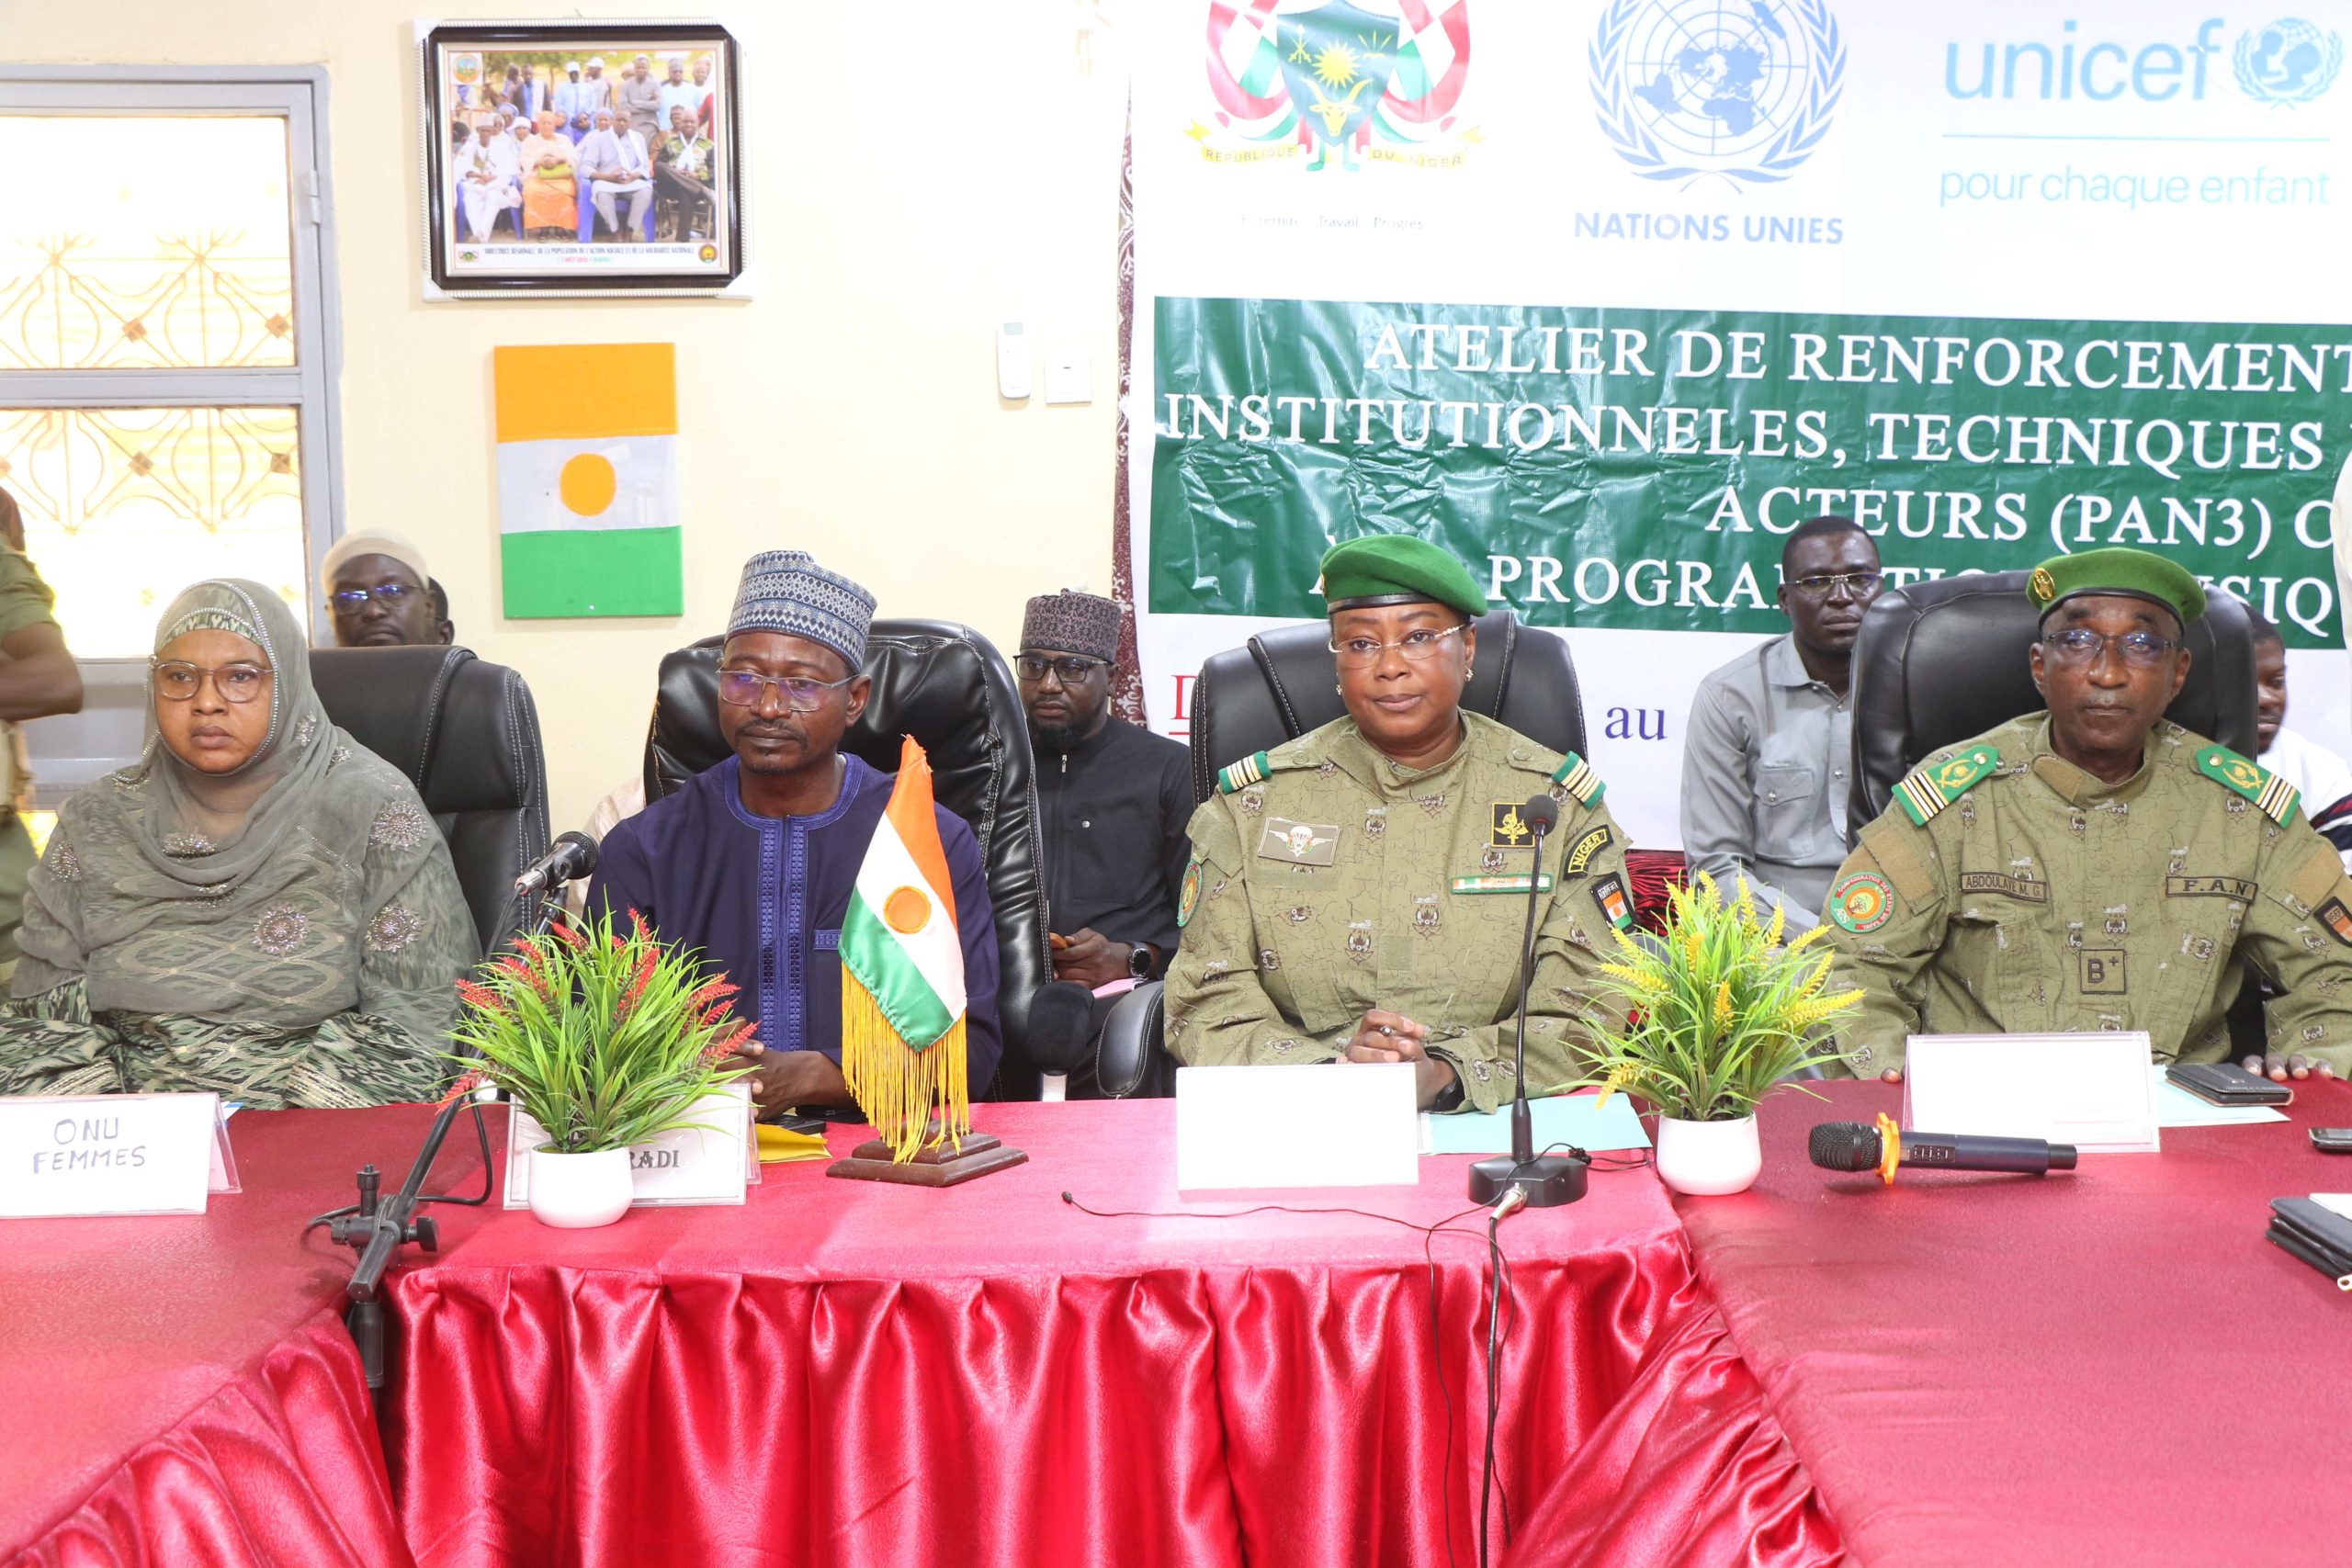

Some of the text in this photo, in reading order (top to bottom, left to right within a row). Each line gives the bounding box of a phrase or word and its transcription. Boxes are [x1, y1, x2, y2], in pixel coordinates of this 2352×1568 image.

[1944, 17, 2224, 102] unicef
[1373, 149, 1395, 160] DU
[1410, 153, 1463, 168] NIGER
[1939, 164, 2331, 210] pour chaque enfant
[1319, 215, 1359, 228] Travail
[1574, 212, 1844, 244] NATIONS UNIES
[1363, 322, 1656, 376] ATELIER
[1673, 329, 1768, 379] DE
[1164, 392, 2324, 480] INSTITUTIONNELES, TECHNIQUES
[1704, 484, 2028, 541] ACTEURS
[2050, 493, 2272, 559] (PAN3)
[1605, 706, 1668, 741] au
[1572, 834, 1600, 866] NIGER
[2183, 879, 2248, 896] F.A.N
[54, 1117, 119, 1145] ONU
[33, 1145, 146, 1174] FEMMES
[629, 1150, 679, 1170] RADI
